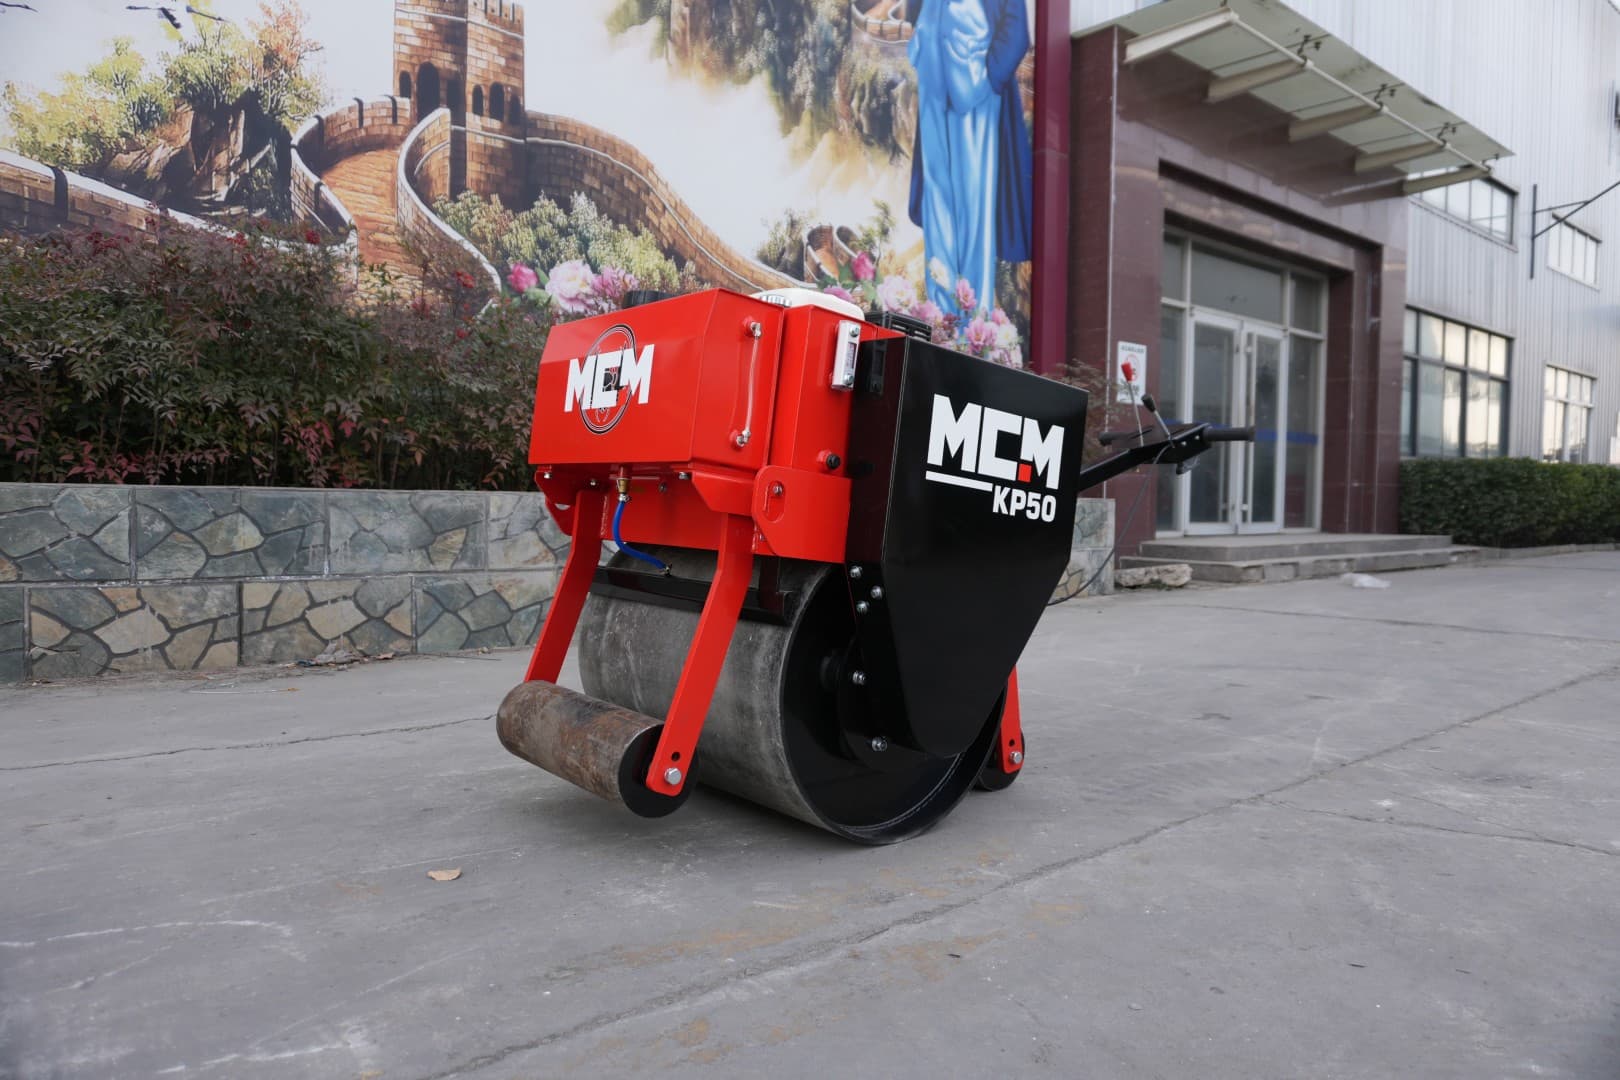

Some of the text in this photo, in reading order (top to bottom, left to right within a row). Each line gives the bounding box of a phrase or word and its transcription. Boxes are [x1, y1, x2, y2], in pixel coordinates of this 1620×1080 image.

[564, 344, 655, 413] MCM
[927, 393, 1065, 490] MCM
[992, 485, 1057, 522] KP50
